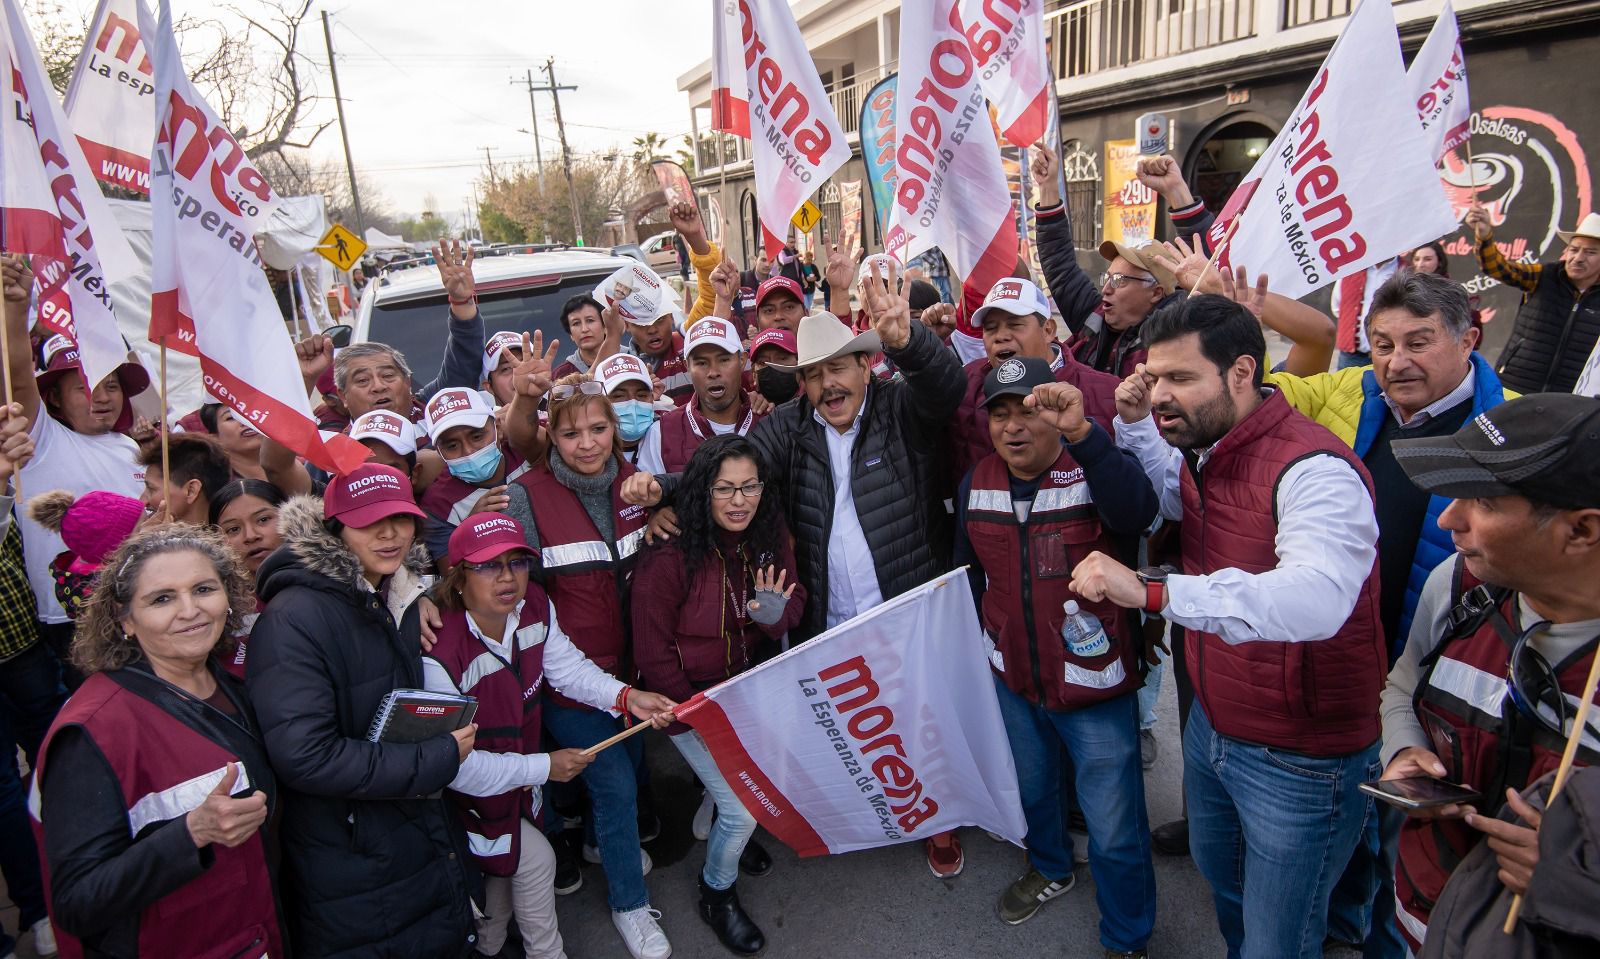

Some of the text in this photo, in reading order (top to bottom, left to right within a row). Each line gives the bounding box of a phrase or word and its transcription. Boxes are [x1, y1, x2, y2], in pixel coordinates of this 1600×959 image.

[89, 54, 111, 79] La
[766, 125, 812, 184] México
[1281, 203, 1292, 224] de
[1284, 222, 1320, 286] México
[632, 267, 658, 290] GUADIANA
[691, 326, 725, 340] morena
[755, 330, 784, 345] morena
[488, 336, 520, 354] morena
[604, 362, 641, 377] morena
[432, 397, 469, 420] morena
[358, 421, 400, 434] morena
[347, 474, 399, 493] morena
[473, 518, 516, 533] morena
[730, 592, 742, 619] morena
[416, 705, 445, 713] morena
[817, 655, 939, 834] morena
[797, 677, 903, 840] La Esperanza de México
